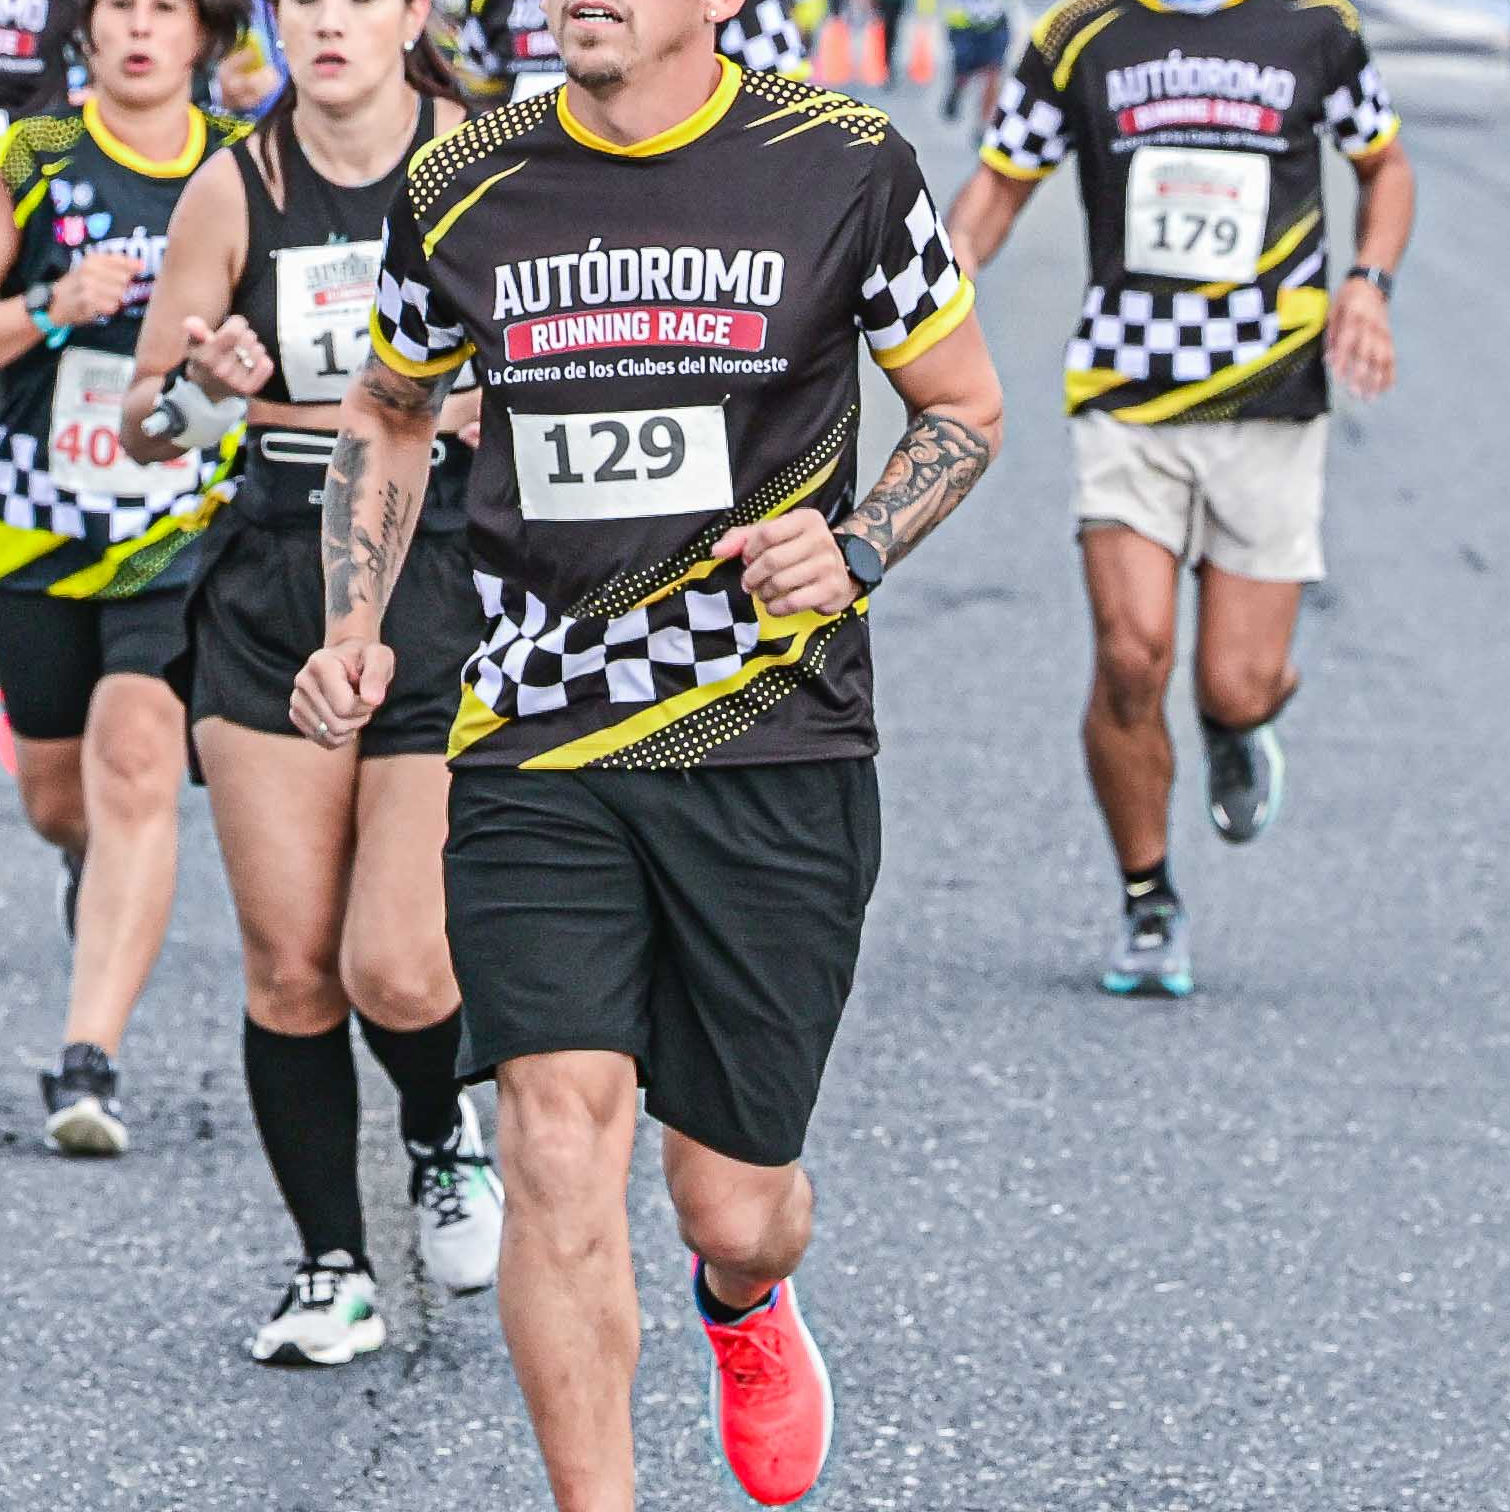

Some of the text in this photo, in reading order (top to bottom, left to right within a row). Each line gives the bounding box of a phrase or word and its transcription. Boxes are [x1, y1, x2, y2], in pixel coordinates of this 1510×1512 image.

[1151, 211, 1240, 256] 179
[493, 238, 785, 320] AUTÓDROMO
[531, 311, 733, 354] RUNNING RACE
[503, 366, 561, 384] Carrera
[564, 361, 587, 379] de
[589, 360, 614, 378] los
[617, 358, 676, 376] Clubes
[678, 356, 706, 374] del
[709, 356, 789, 374] Noroeste
[544, 416, 686, 484] 129
